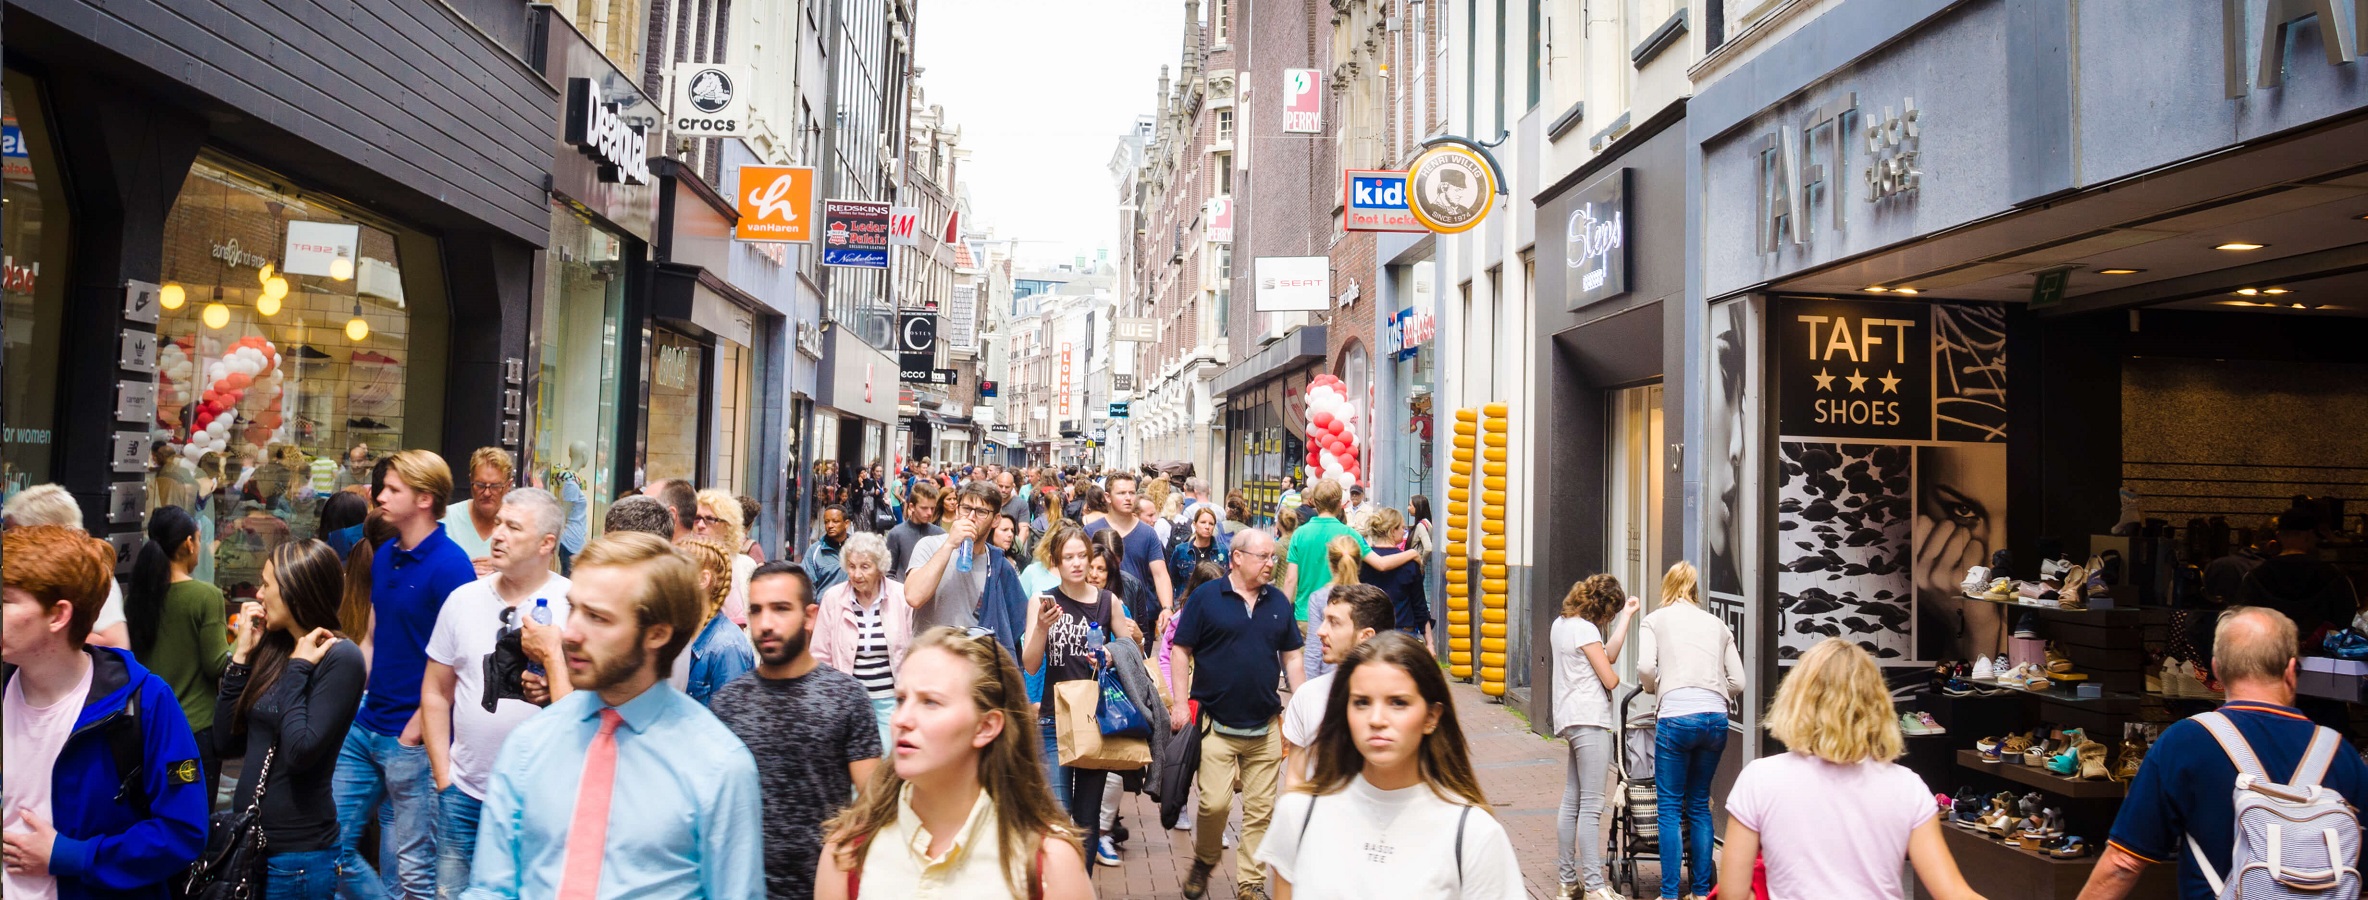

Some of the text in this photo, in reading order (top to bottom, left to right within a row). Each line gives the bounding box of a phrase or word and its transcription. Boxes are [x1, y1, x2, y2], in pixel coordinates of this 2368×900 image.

[678, 117, 736, 132] crocs
[1287, 111, 1320, 131] PERRY
[1421, 155, 1482, 179] HENRI WILLIG
[1748, 91, 1857, 257] TAFT
[1864, 151, 1923, 203] SHOES
[1355, 179, 1407, 205] kid
[828, 204, 889, 214] REDSKINS
[1353, 213, 1379, 225] Foot
[1431, 211, 1471, 223] SINCE 1974
[747, 223, 799, 233] vanHaren
[851, 220, 887, 232] Leder
[1209, 227, 1232, 241] PERRY
[1567, 202, 1621, 277] Steps
[1280, 279, 1324, 287] SEAT
[1120, 321, 1152, 337] WE
[1798, 315, 1915, 363] TAFT
[900, 370, 925, 378] ecco
[1060, 343, 1070, 414] BLOKKER
[1814, 399, 1900, 425] SHOES
[3, 423, 51, 444] or women
[1069, 643, 1090, 656] LOS
[1364, 842, 1395, 855] BASIC
[1368, 853, 1386, 864] TEE
